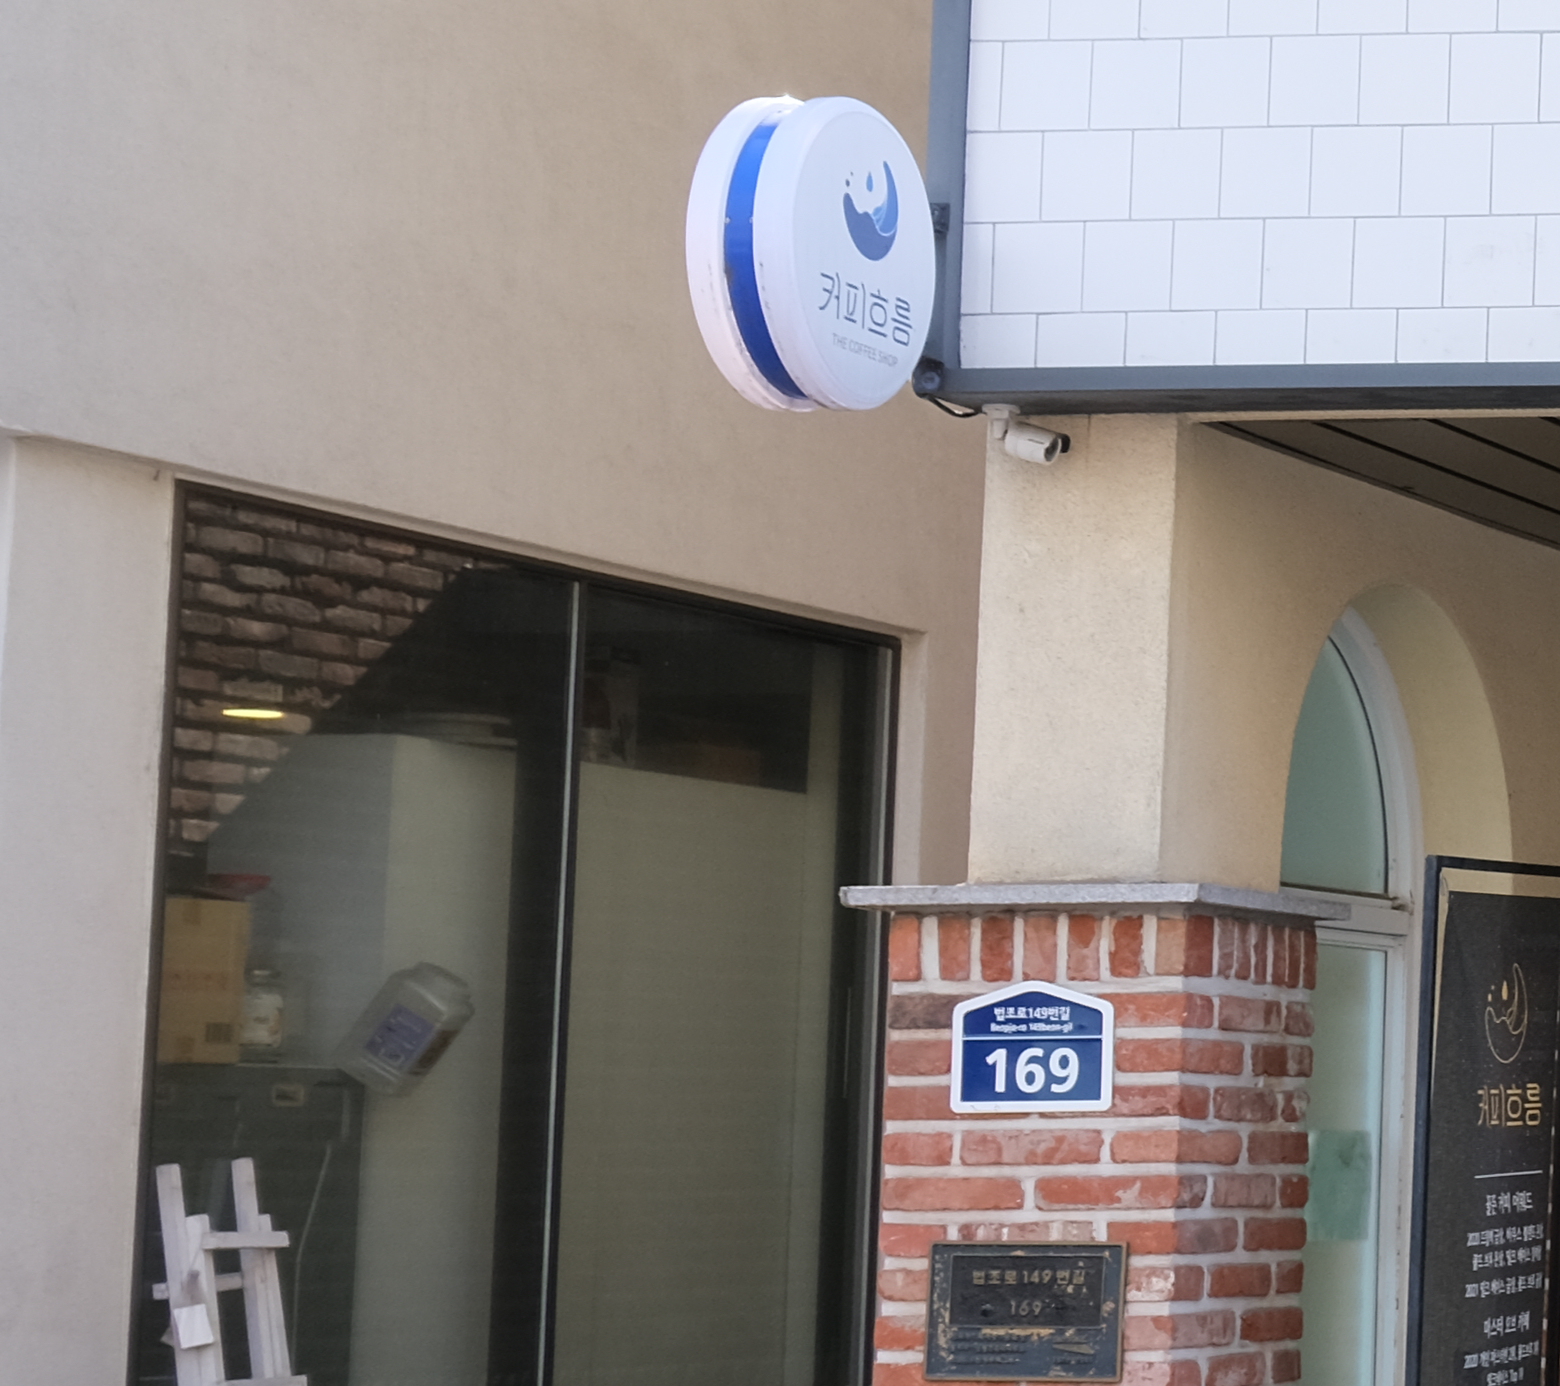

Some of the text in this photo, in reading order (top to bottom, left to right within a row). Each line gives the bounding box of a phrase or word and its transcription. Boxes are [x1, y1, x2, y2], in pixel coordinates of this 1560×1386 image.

[818, 271, 913, 347] 커피흐름
[832, 332, 898, 368] THE COFFEE SHOP
[994, 1006, 1070, 1021] 법조로149번길
[985, 1047, 1079, 1093] 169
[1477, 1083, 1542, 1128] 커피흐름
[1010, 1299, 1043, 1316] 169
